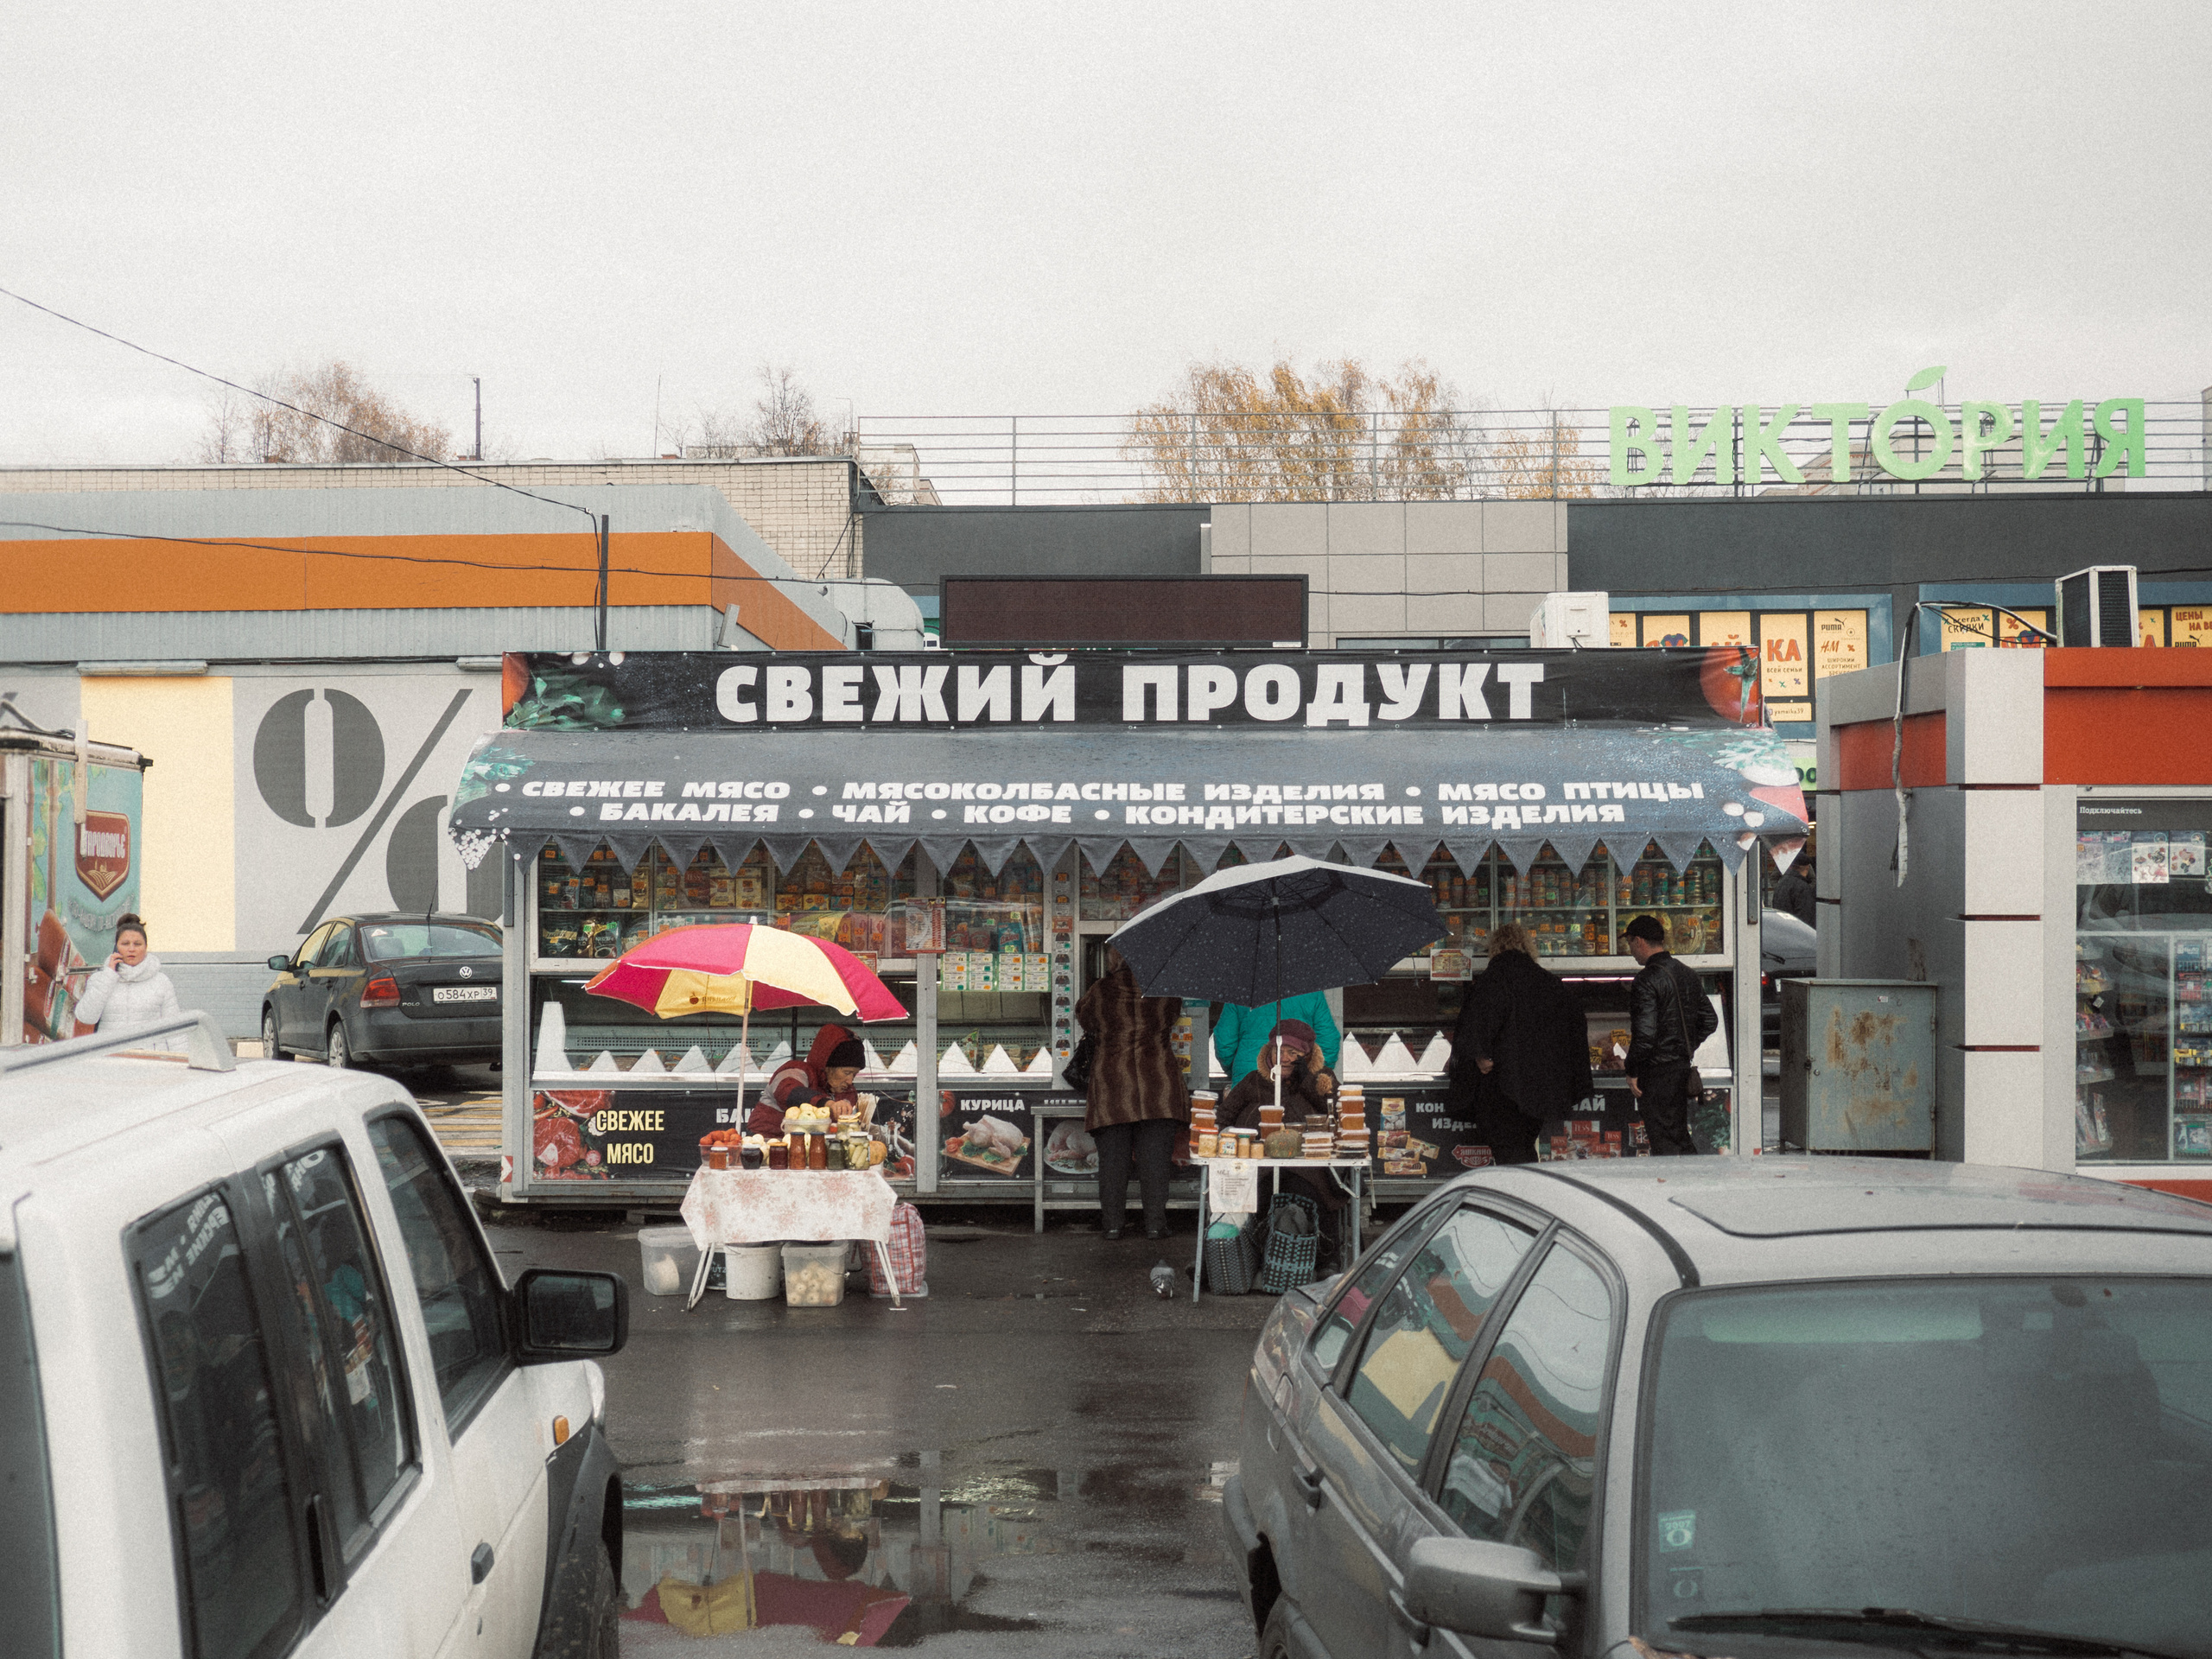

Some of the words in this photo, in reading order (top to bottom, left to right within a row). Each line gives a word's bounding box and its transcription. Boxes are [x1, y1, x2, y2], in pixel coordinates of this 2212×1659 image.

[1609, 398, 2145, 485] ВИКТОРИЯ
[2176, 611, 2203, 621] ЦЕНЫ
[2190, 622, 2202, 631] НА
[1767, 639, 1802, 662] КА
[716, 653, 1076, 723] СВЕЖИЙ
[1123, 664, 1544, 727] ПРОДУКТ
[522, 781, 666, 798] СВЕЖЕЕ
[682, 782, 791, 799] МЯСО
[842, 782, 1186, 802] МЯСОКОЛБАСНЫЕ
[1204, 783, 1386, 804] ИЗДЕЛИЯ
[1438, 783, 1547, 801] МЯСО
[1563, 782, 1705, 804] ПТИЦЫ
[600, 803, 779, 823] БАКАЛЕЯ
[831, 800, 912, 824] ЧАЙ
[963, 804, 1072, 825] КОФЕ
[1126, 804, 1424, 830] КОНДИТЕРСКИЕ
[1441, 804, 1626, 830] ИЗДЕЛИЯ
[2079, 806, 2143, 815] Подключайтесь
[482, 988, 493, 996] 39
[960, 1099, 1026, 1112] КУРИЦА
[596, 1110, 665, 1132] СВЕЖЕЕ
[607, 1142, 654, 1165] МЯСО
